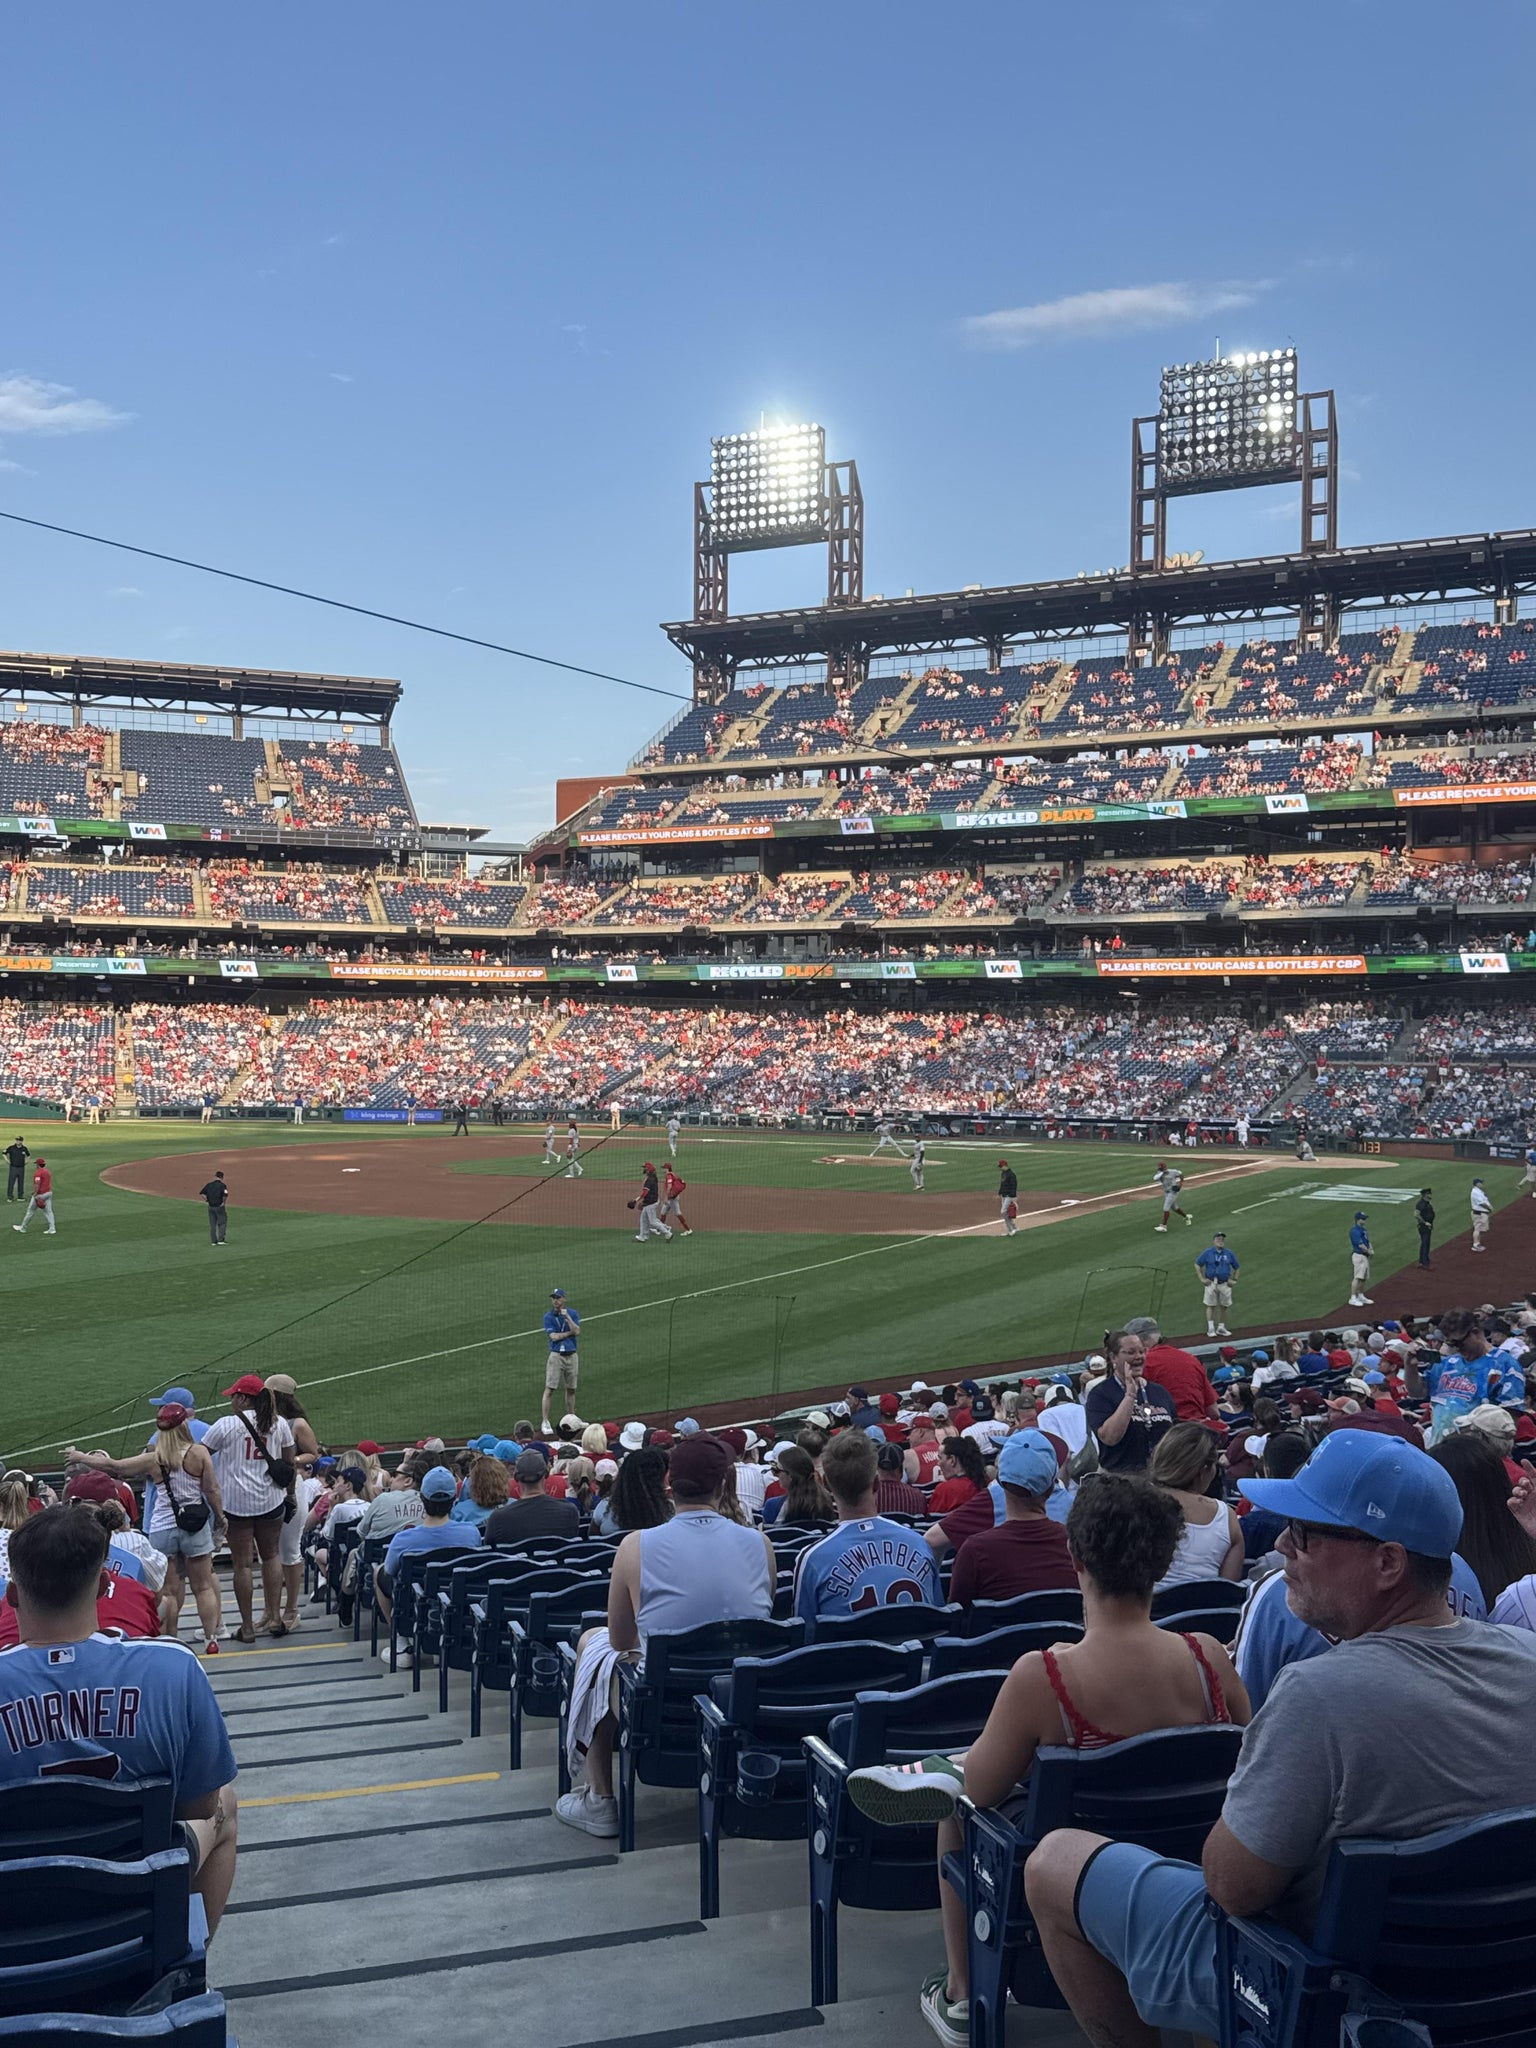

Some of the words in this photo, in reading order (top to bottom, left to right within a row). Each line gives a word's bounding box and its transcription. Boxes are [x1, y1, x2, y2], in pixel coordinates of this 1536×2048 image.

[1398, 790, 1445, 802] PLEASE
[1446, 787, 1502, 799] RECYCLE
[1503, 786, 1536, 796] YOUR
[1272, 798, 1302, 809] WM
[1152, 805, 1181, 815] WM
[956, 811, 1038, 827] RECYCLED
[1040, 808, 1095, 823] PLAYS
[24, 821, 51, 831] WM
[134, 826, 162, 836] WM
[845, 821, 870, 831] WM
[580, 833, 611, 842] PLEASE
[611, 831, 648, 841] RECYCLE
[648, 829, 671, 839] YOUR
[671, 829, 694, 839] CANS
[694, 830, 702, 838] &
[701, 827, 740, 838] BOTTLES
[740, 827, 751, 835] AT
[752, 825, 770, 835] CBP
[56, 961, 89, 969] PRESENTED
[112, 961, 141, 971] WM
[1101, 961, 1142, 972] PLEASE
[1143, 961, 1192, 972] RECYCLE
[1193, 961, 1223, 971] YOUR
[1224, 960, 1256, 971] CANS
[1256, 960, 1266, 970] &
[1266, 959, 1319, 970] BOTTLES
[1320, 959, 1336, 969] AT
[1338, 959, 1362, 970] CBP
[1468, 958, 1503, 968] WM
[225, 964, 252, 973] WM
[333, 966, 372, 976] PLEASE
[372, 967, 414, 977] RECYCLE
[415, 968, 442, 977] YOUR
[442, 969, 467, 978] CANS
[468, 969, 476, 978] &
[476, 969, 516, 979] BOTTLES
[516, 970, 527, 978] AT
[527, 969, 544, 978] CBP
[611, 968, 634, 978] WM
[709, 965, 783, 978] RECYCLED
[784, 965, 834, 977] PLAYS
[885, 965, 912, 975] WM
[990, 964, 1018, 974] WM
[826, 1540, 932, 1599] SCHWARBER
[0, 1686, 141, 1755] TURNER
